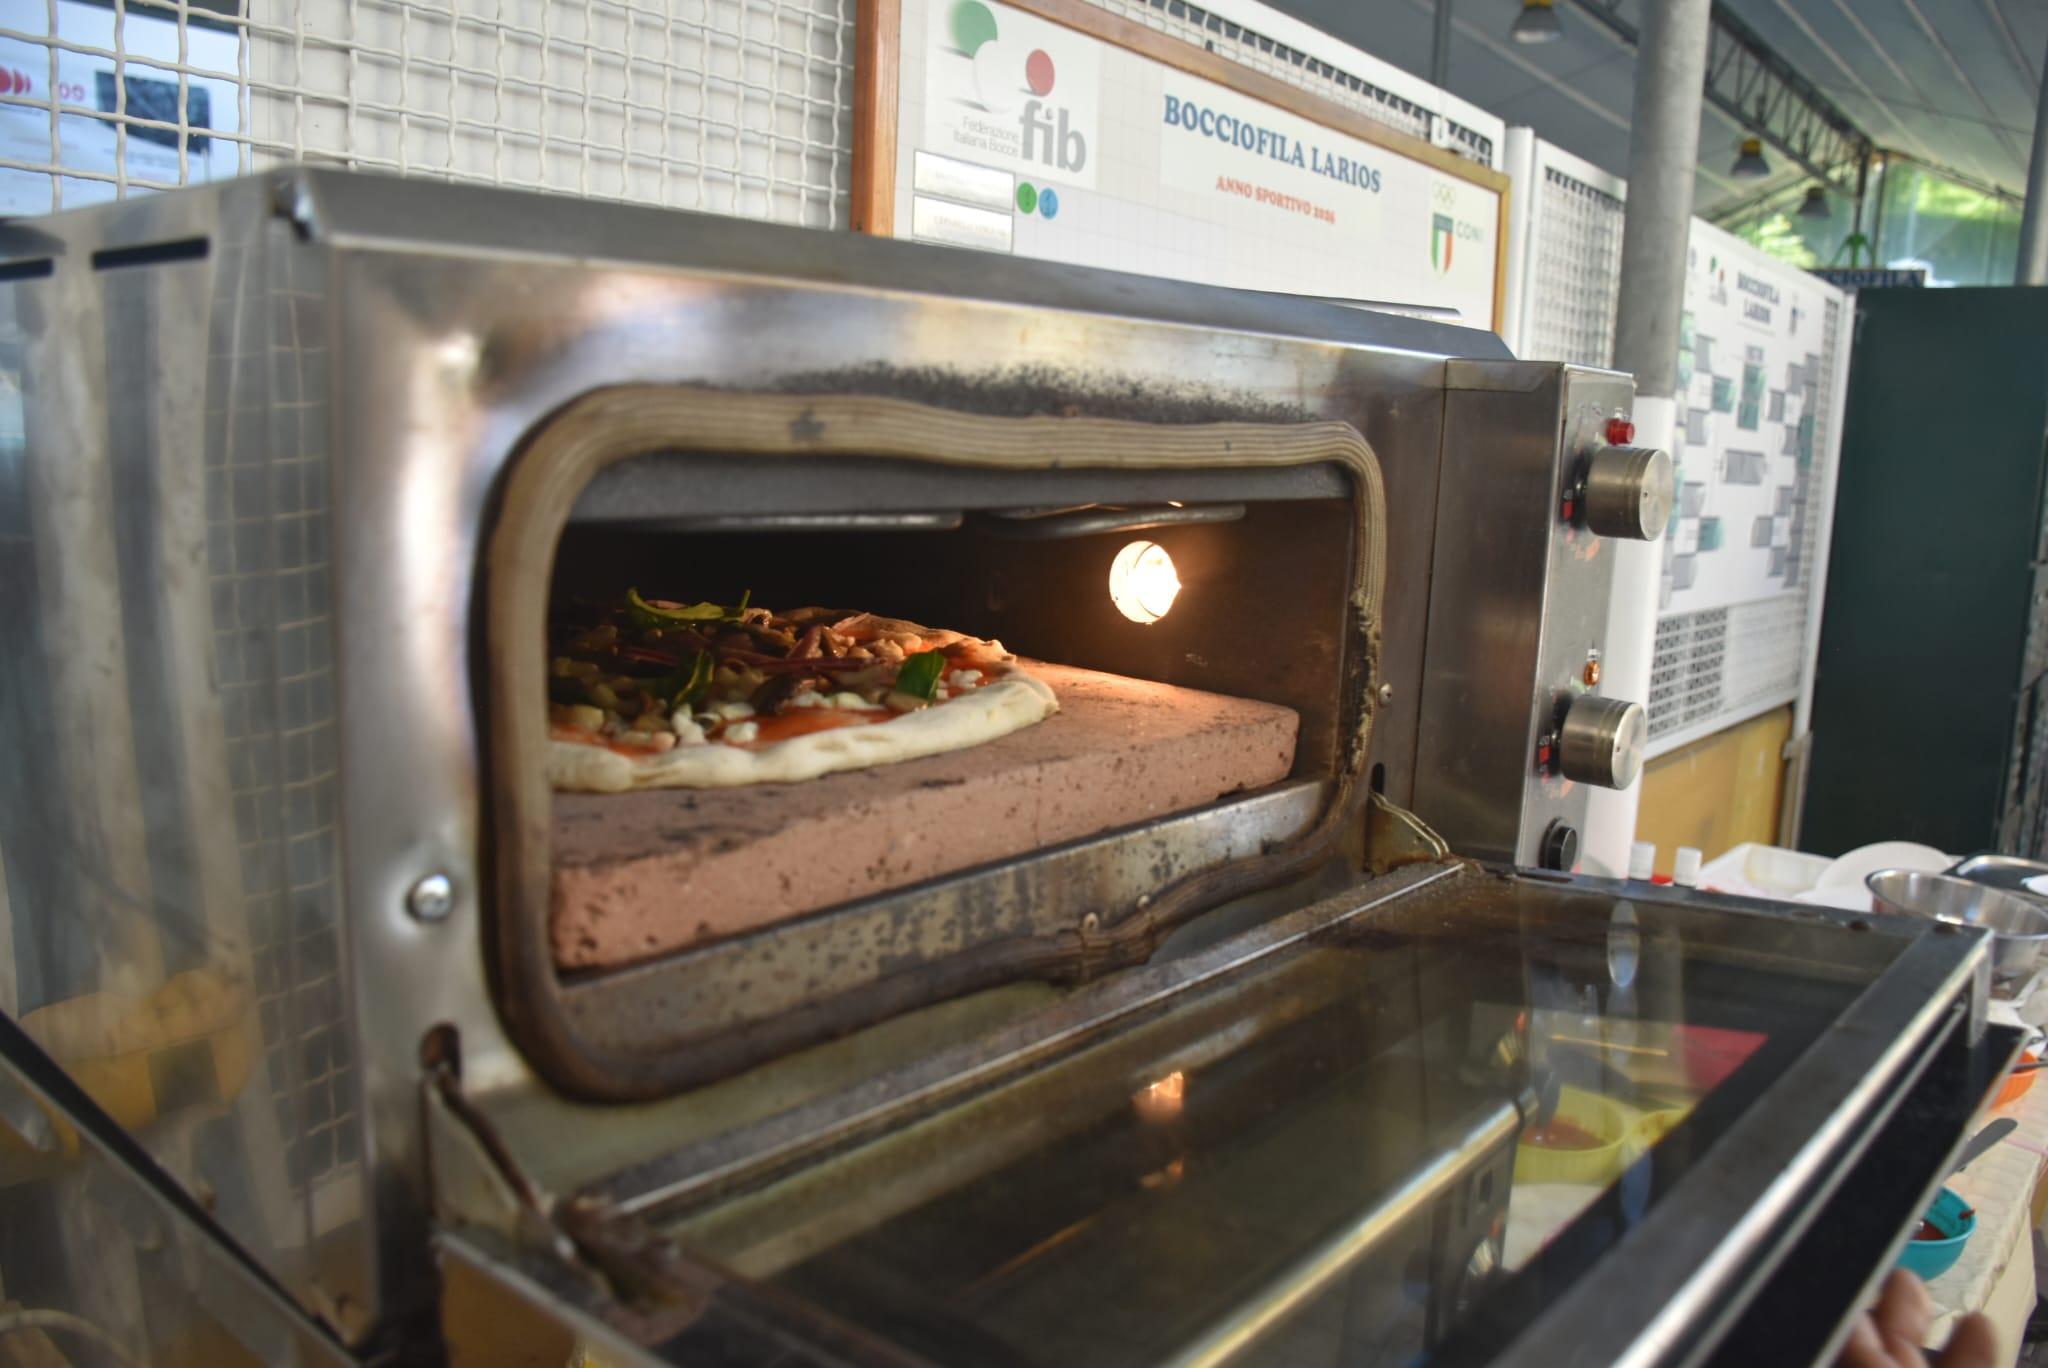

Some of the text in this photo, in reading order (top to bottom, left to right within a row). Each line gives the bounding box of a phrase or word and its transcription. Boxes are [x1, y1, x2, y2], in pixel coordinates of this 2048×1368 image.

[1019, 99, 1086, 173] fib
[1164, 95, 1381, 193] BOCCIOFILA LARIOS
[1216, 176, 1252, 198] ANNO
[1256, 187, 1311, 215] SPORTIVO
